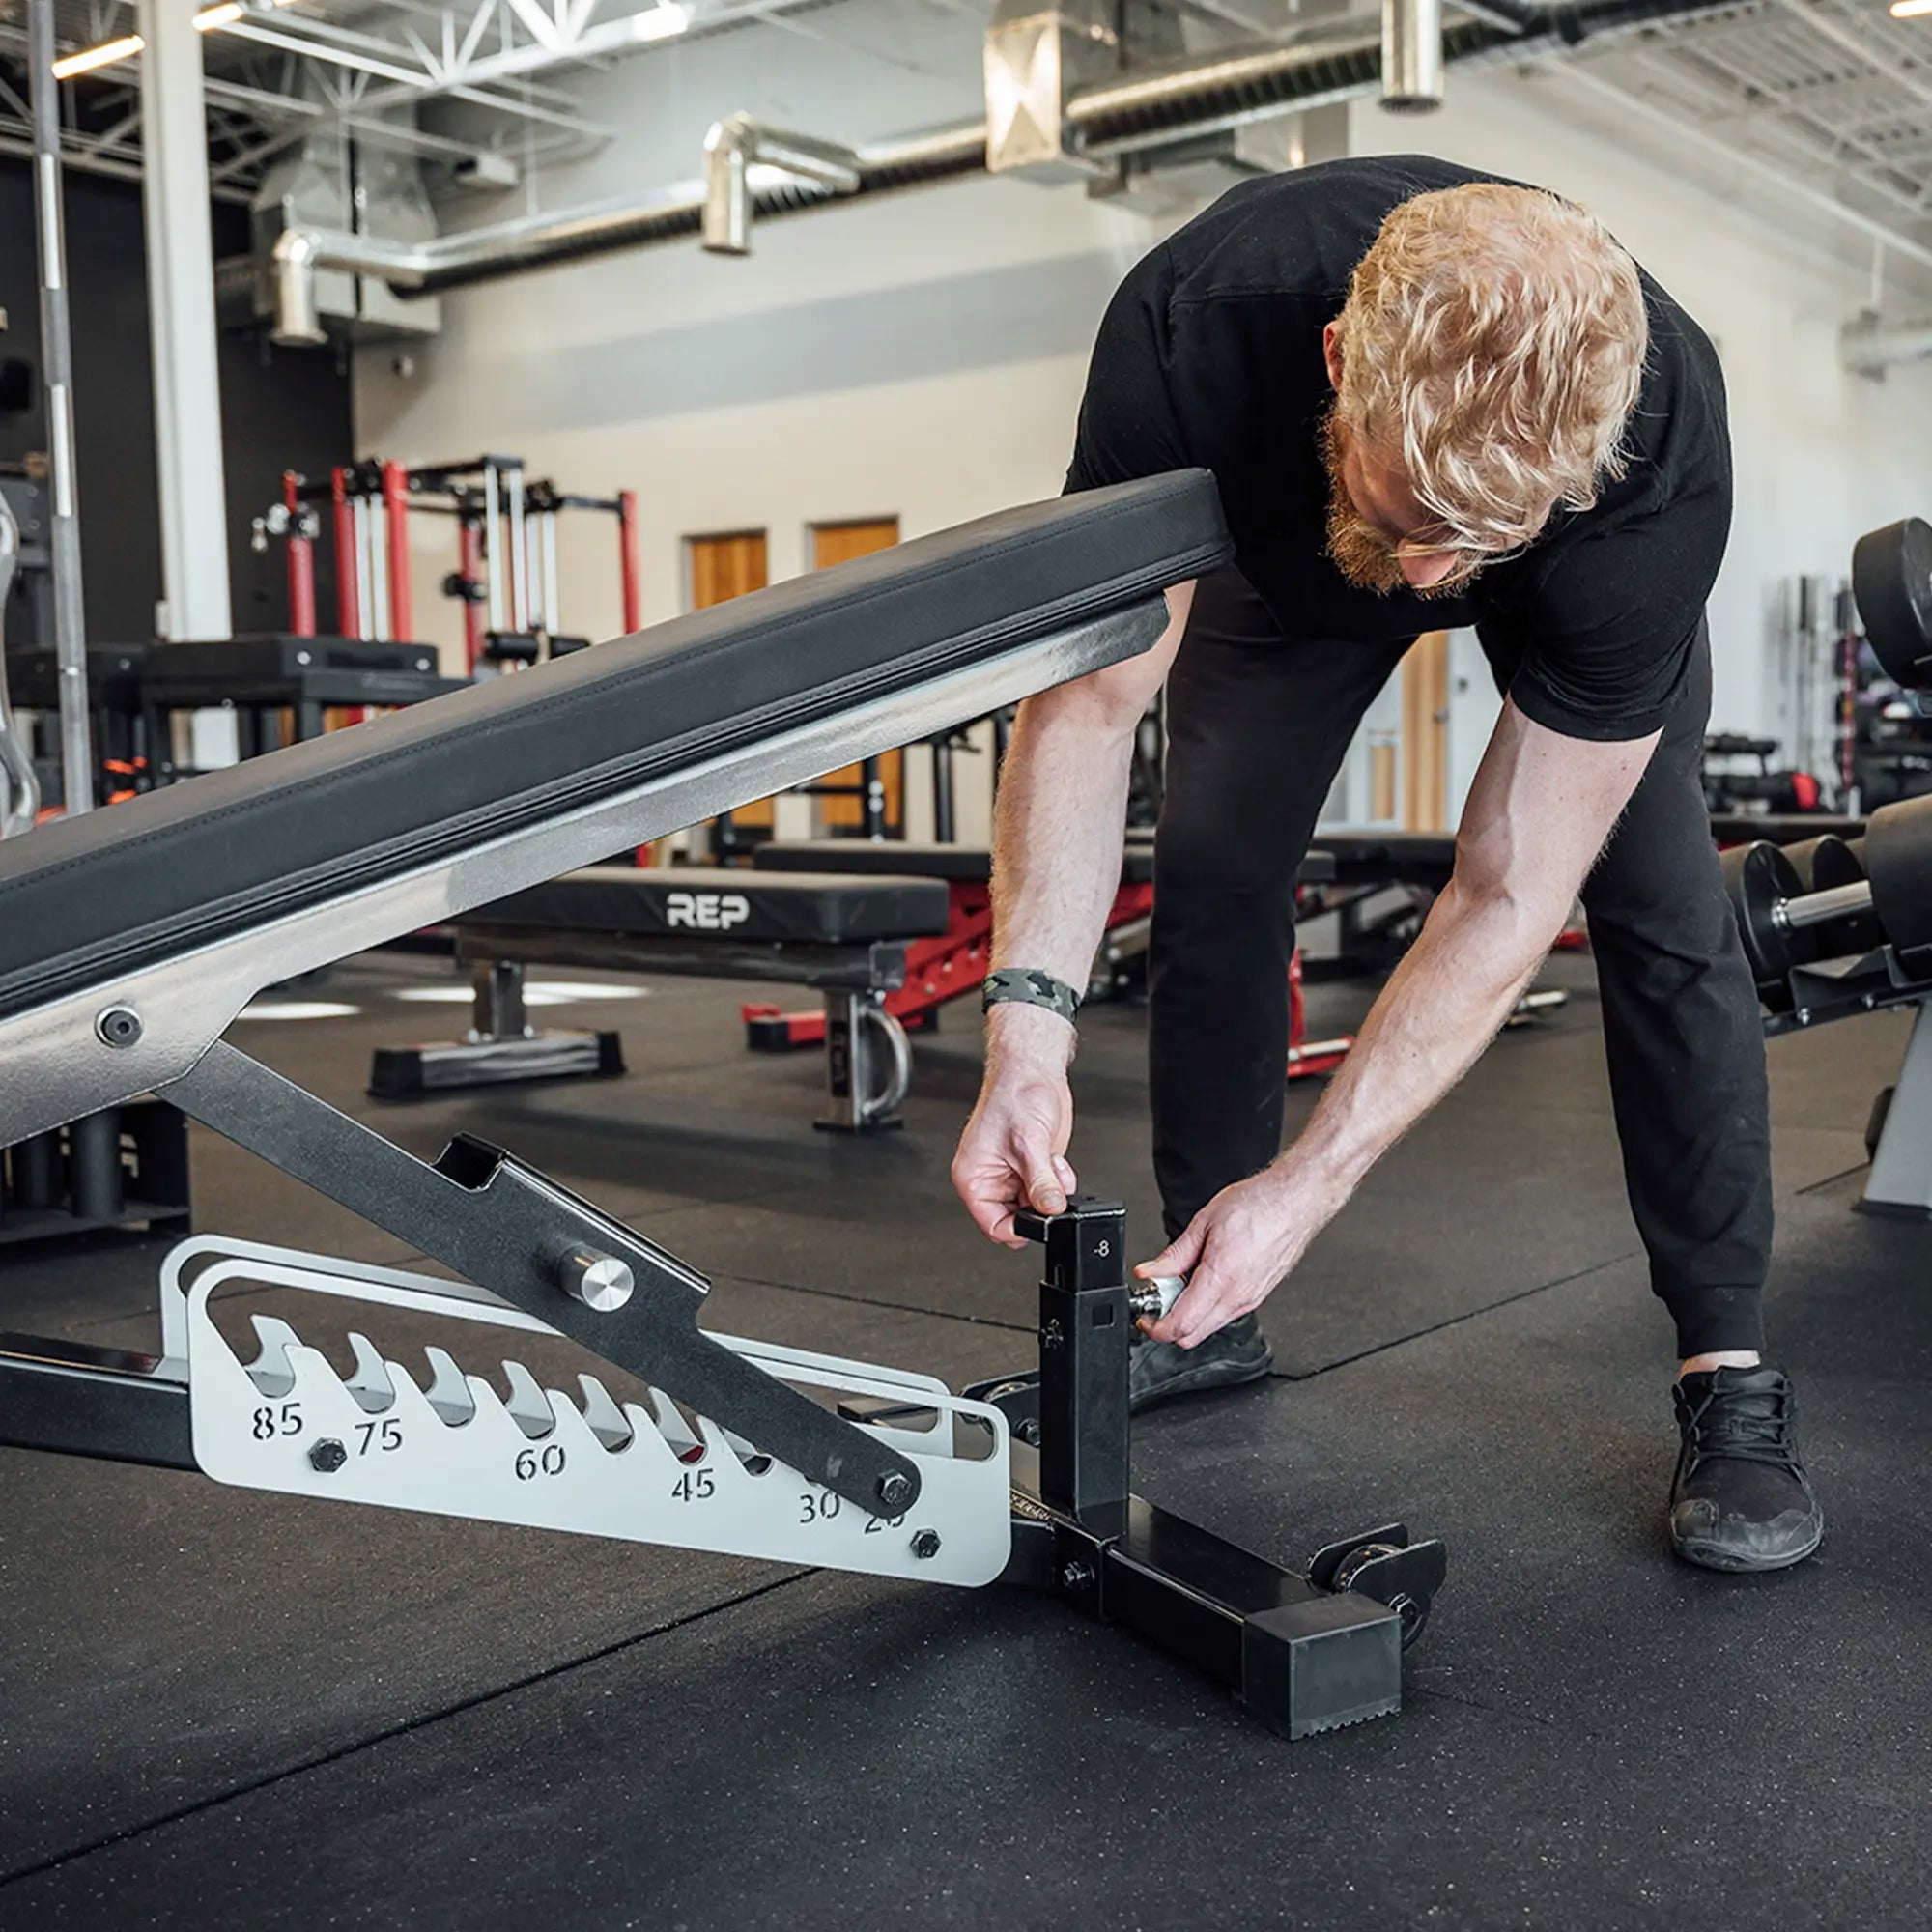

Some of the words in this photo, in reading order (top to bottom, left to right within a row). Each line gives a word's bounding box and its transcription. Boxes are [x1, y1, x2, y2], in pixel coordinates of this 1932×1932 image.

[667, 893, 750, 929] REP
[1094, 1239, 1110, 1258] -8
[252, 1402, 303, 1440] 85
[355, 1418, 403, 1456] 75
[515, 1444, 566, 1481] 60
[671, 1467, 715, 1502] 45
[800, 1490, 840, 1523] 30
